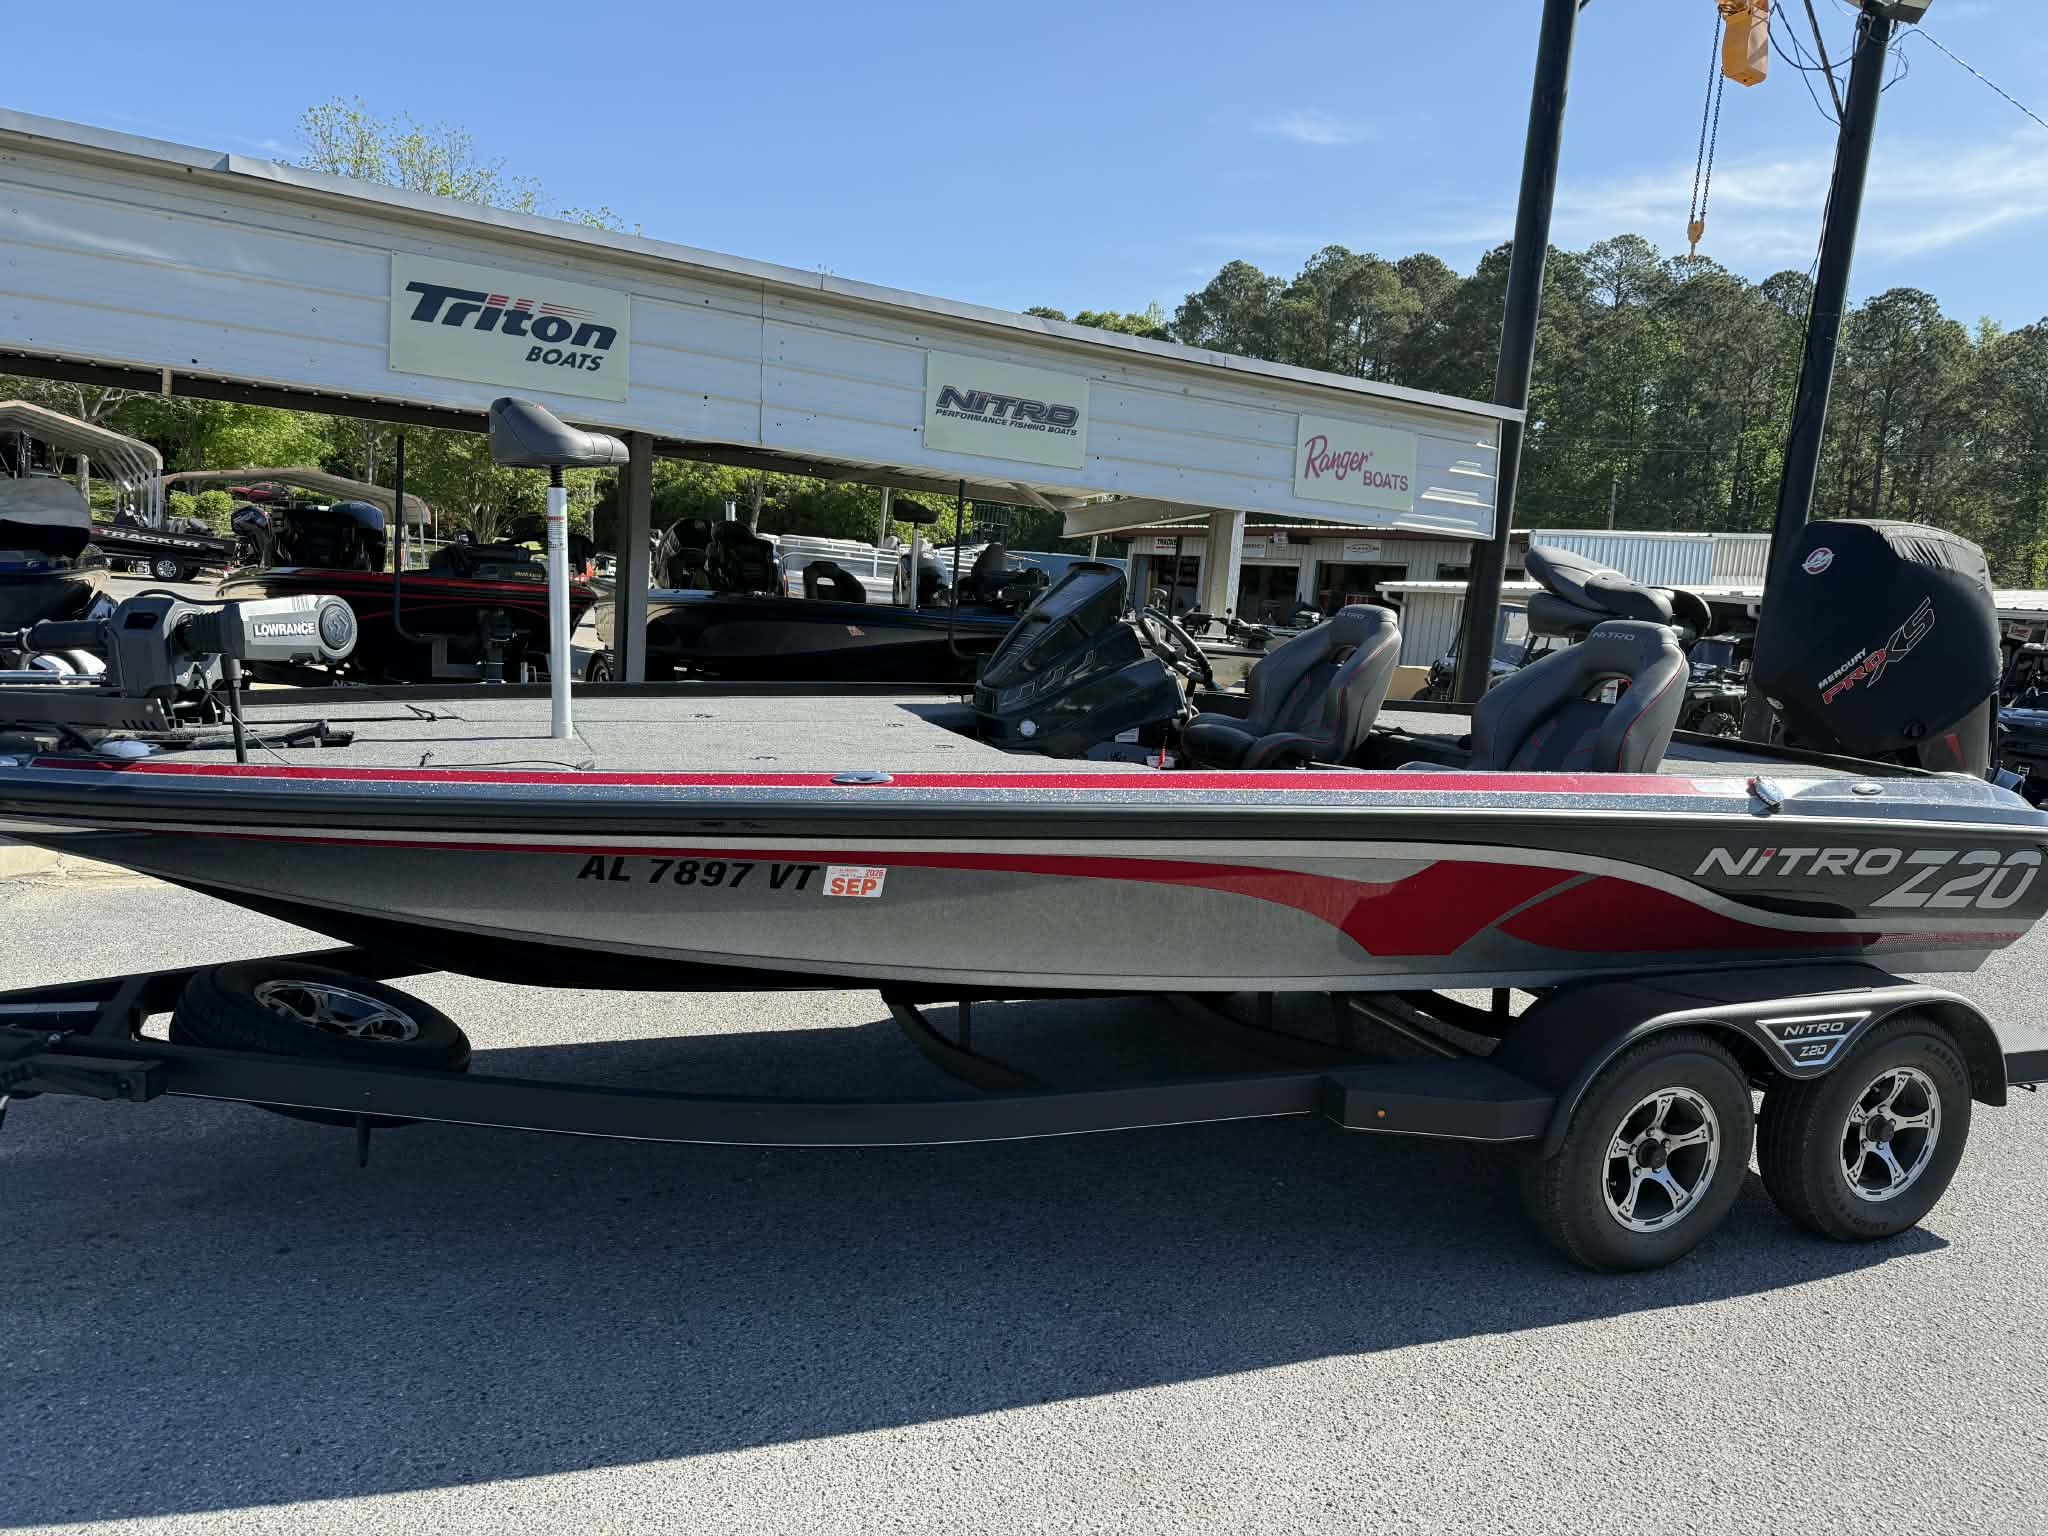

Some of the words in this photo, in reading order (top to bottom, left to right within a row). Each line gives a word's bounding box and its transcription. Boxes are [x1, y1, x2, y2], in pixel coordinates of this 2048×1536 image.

[405, 280, 618, 351] Triton
[525, 346, 605, 372] BOATS
[935, 408, 1008, 426] PERFORMANCE
[1009, 420, 1047, 432] FISHING
[1048, 426, 1078, 437] BOATS
[1304, 435, 1369, 481] Ranger
[1363, 470, 1409, 491] BOATS
[101, 529, 200, 548] TRACKER
[254, 622, 316, 636] LOWRANCE
[1818, 647, 1866, 690] MERCURY
[577, 855, 632, 882] AL
[648, 858, 755, 888] 7897
[767, 863, 821, 890] VT
[1868, 849, 2042, 908] Z20
[831, 877, 877, 896] SEP
[1784, 1022, 1845, 1036] NITRO
[1800, 1044, 1828, 1057] Z20
